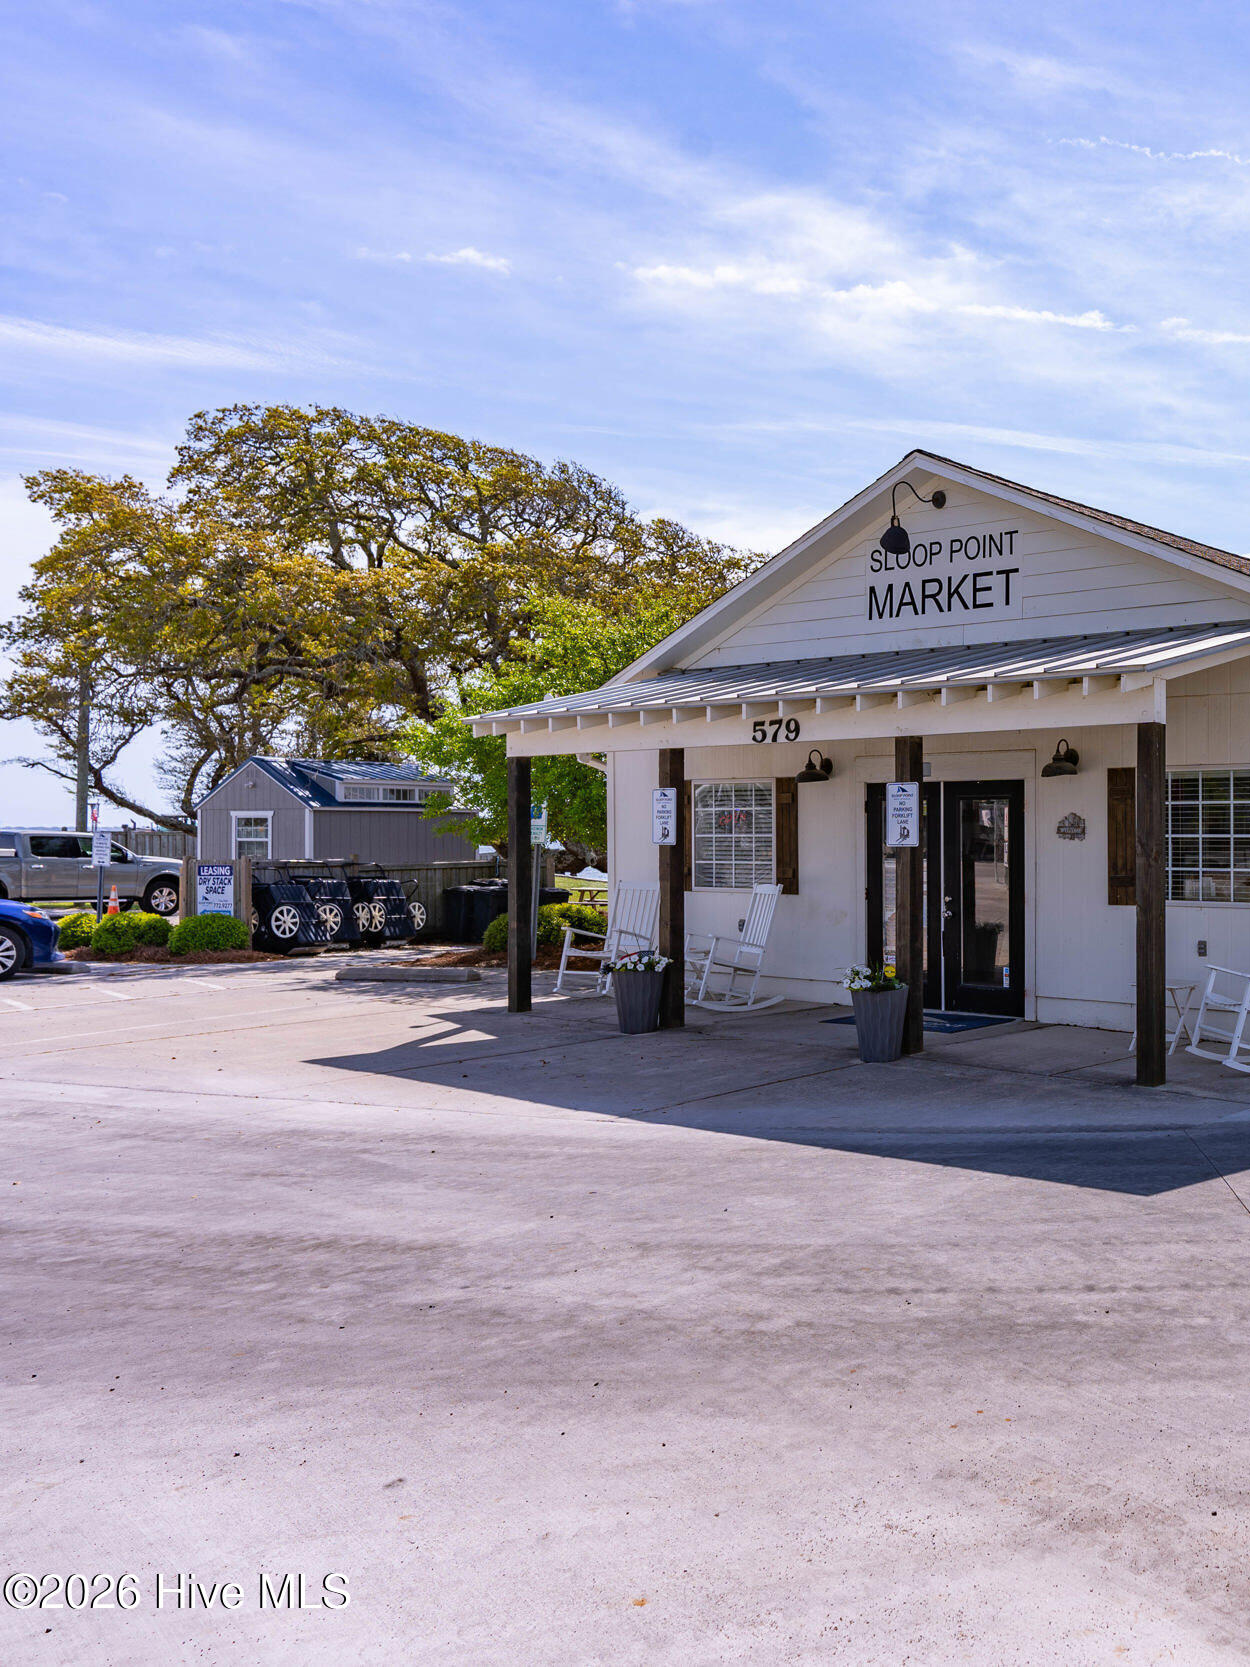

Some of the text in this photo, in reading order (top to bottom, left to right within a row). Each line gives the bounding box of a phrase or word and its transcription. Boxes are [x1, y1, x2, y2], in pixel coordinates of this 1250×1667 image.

[870, 530, 1018, 572] SLOOP POINT
[868, 568, 1019, 620] MARKET
[752, 718, 800, 743] 579
[200, 866, 231, 876] LEASING
[199, 877, 232, 886] DRY STACK
[205, 886, 225, 895] SPACE
